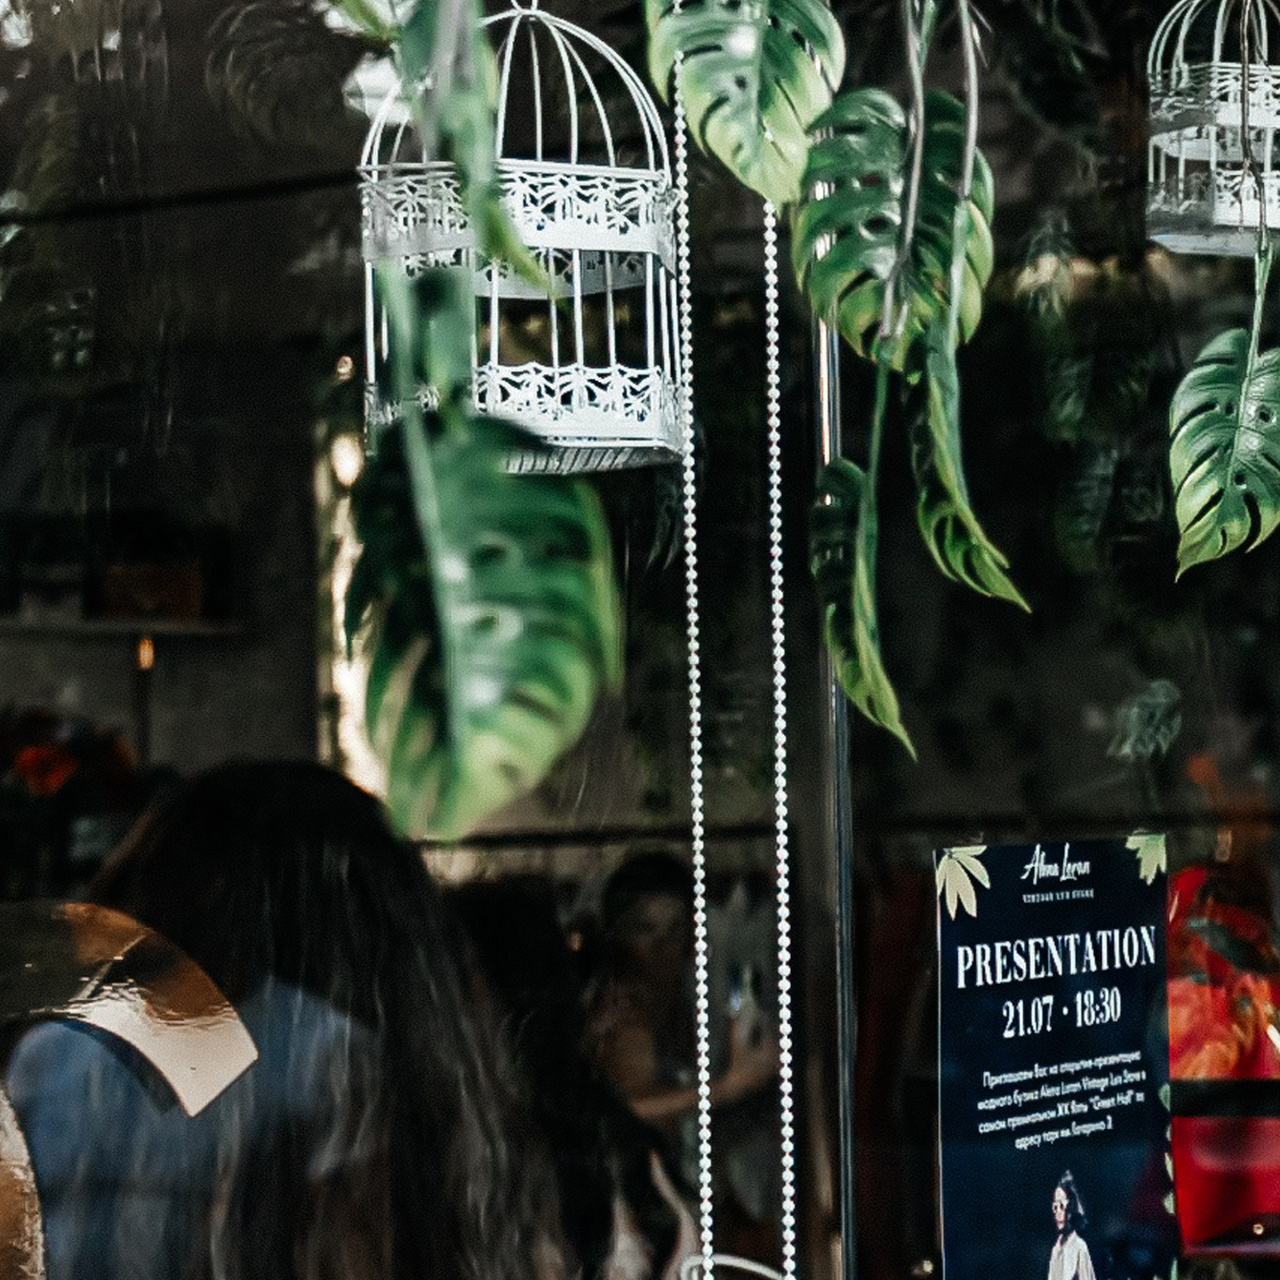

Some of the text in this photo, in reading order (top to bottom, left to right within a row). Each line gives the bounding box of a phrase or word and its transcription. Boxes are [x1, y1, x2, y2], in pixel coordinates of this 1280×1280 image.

[957, 926, 1156, 989] PRESENTATION
[1003, 987, 1122, 1039] 21.07 18:30
